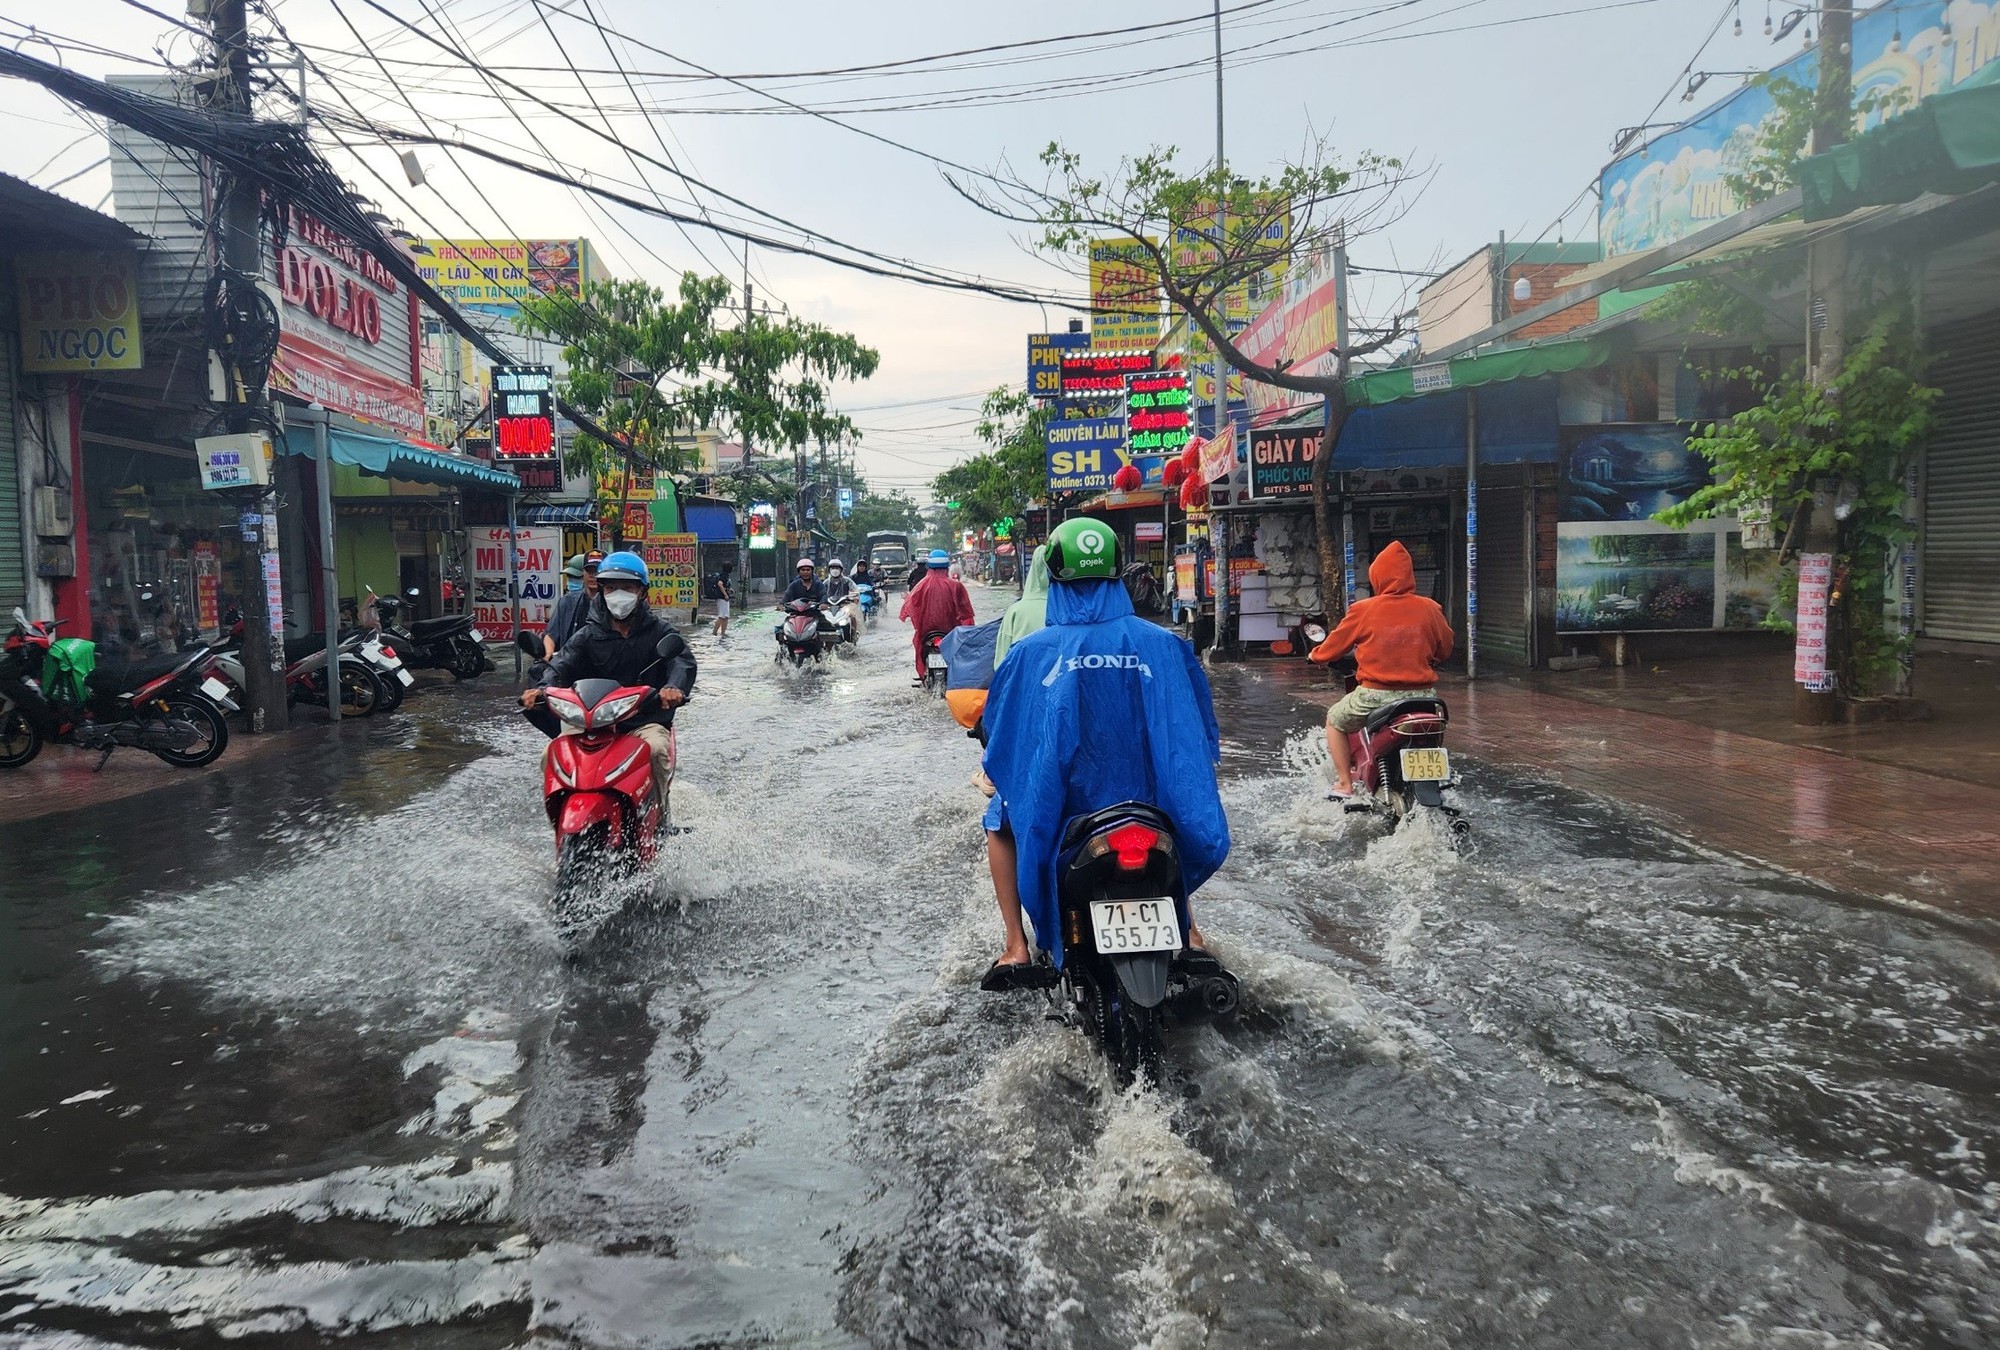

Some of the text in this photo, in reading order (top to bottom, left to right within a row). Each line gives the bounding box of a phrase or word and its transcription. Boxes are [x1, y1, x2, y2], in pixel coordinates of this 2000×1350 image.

[439, 242, 524, 260] PHÚC MINH TIẾN
[502, 266, 524, 280] CAY
[276, 246, 381, 345] DOLIO
[37, 326, 127, 369] NGỌC
[1095, 340, 1108, 349] THU
[1131, 336, 1143, 347] GIÁ
[518, 374, 548, 391] TRANG
[506, 395, 540, 414] NAM
[1130, 393, 1155, 408] GIA
[498, 417, 551, 453] DOLIO
[1048, 424, 1093, 443] CHUYÊN
[1095, 421, 1119, 440] LÀM
[1132, 426, 1190, 449] MÂM QUẢ
[1255, 433, 1296, 465] GIÀY
[1302, 430, 1325, 462] DÉ
[1051, 449, 1101, 475] SH
[1050, 476, 1083, 489] Hotline:
[1084, 474, 1106, 486] 0373
[1257, 465, 1290, 484] PHÚC
[476, 543, 552, 571] MÌ CAY
[645, 544, 695, 563] BÊ THUI
[1079, 557, 1104, 568] gojek
[473, 605, 528, 622] TRÀ SA
[1408, 751, 1441, 763] 51-N2
[1409, 765, 1443, 778] 7353
[1104, 903, 1161, 925] 71-C1
[1101, 925, 1176, 949] 555.73
